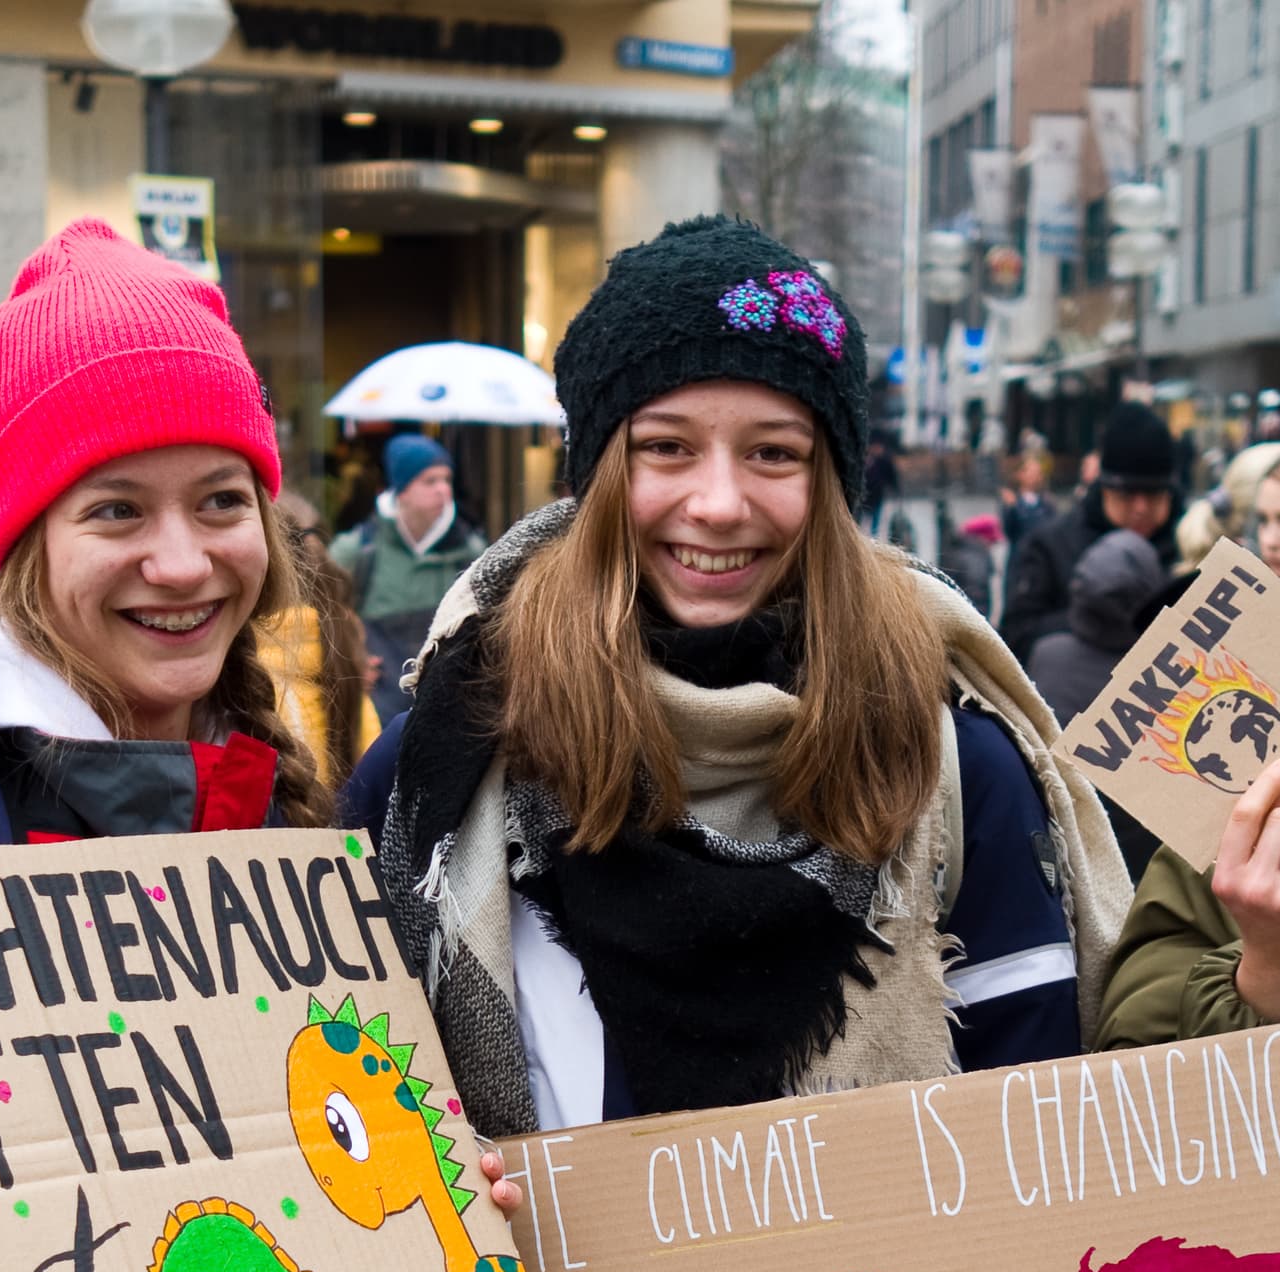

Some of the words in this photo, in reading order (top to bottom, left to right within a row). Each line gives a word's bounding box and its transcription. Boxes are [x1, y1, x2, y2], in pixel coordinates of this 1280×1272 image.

[1072, 642, 1199, 771] WAKE
[1180, 565, 1267, 652] UP!
[207, 856, 421, 988] AUCH
[496, 1135, 587, 1272] HE
[647, 1114, 834, 1244] CLIMATE
[909, 1082, 967, 1217] IS
